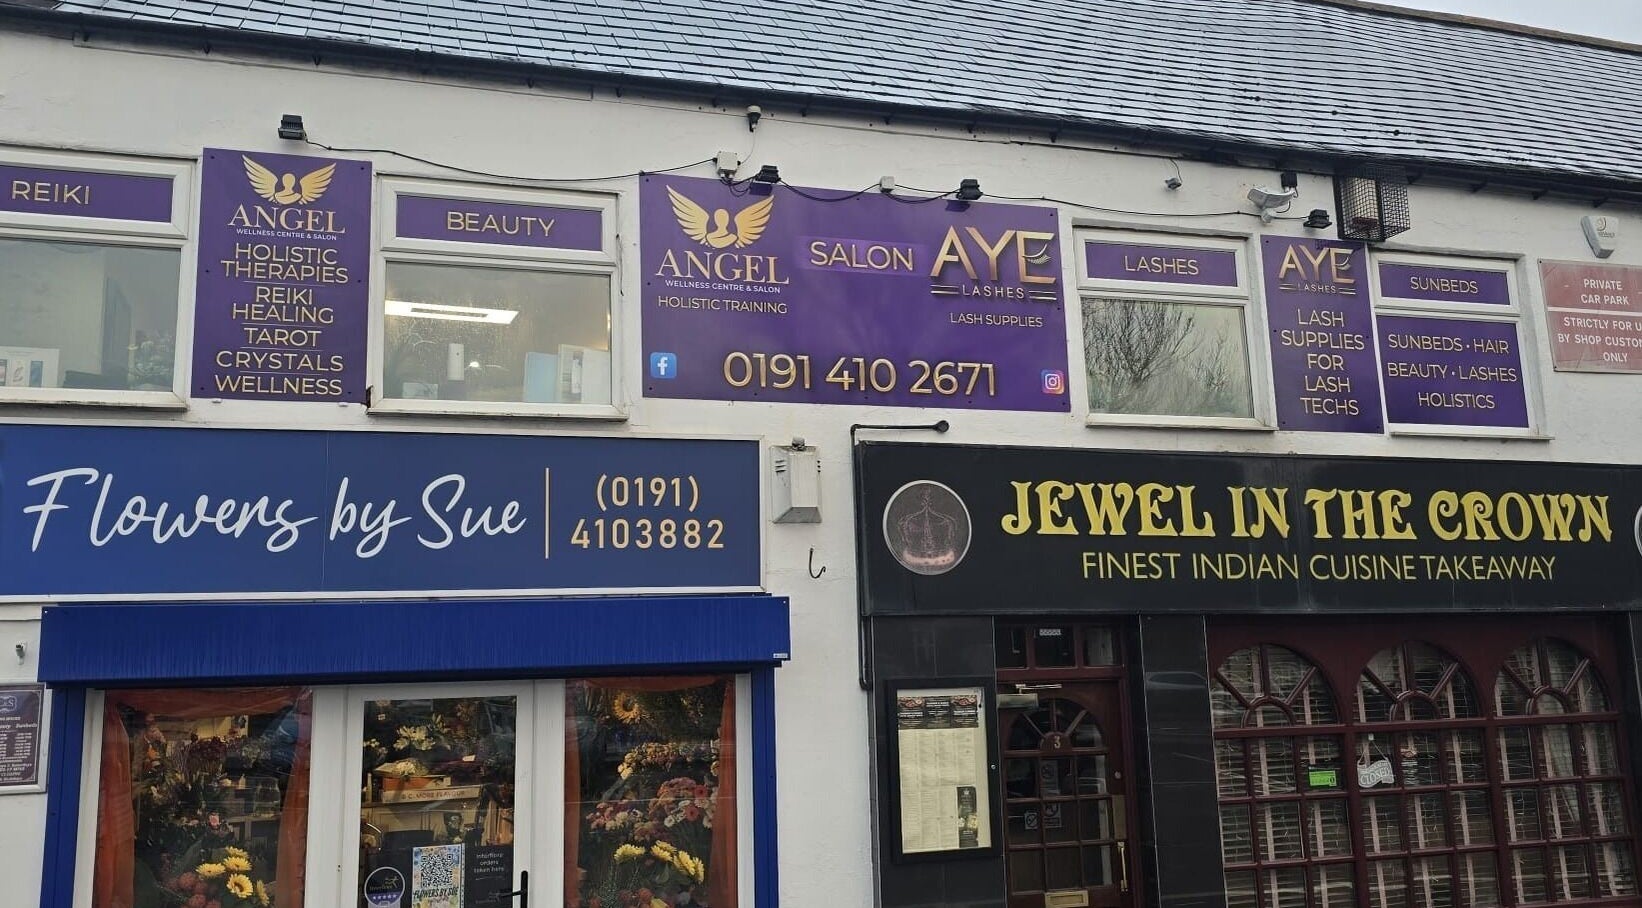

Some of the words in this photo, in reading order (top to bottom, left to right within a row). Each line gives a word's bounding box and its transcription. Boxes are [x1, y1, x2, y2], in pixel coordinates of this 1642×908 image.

[11, 180, 90, 205] REIKI
[227, 203, 346, 234] ANGEL
[446, 211, 556, 237] BEAUTY
[236, 228, 275, 237] WELLNESS
[276, 231, 305, 239] CENTRE
[235, 242, 338, 265] HOLISTIC
[810, 241, 914, 272] SALON
[930, 225, 1057, 284] AYE
[220, 260, 349, 284] THERAPIES
[655, 248, 790, 285] ANGEL
[1124, 255, 1200, 276] LASHES
[1278, 244, 1356, 284] AYE
[665, 279, 710, 289] WELLNESS
[712, 282, 745, 291] CENTRE
[753, 286, 781, 294] SALON
[962, 285, 1025, 299] LASHES
[1297, 283, 1336, 294] LASHES
[1410, 276, 1479, 294] SUNBEDS
[1583, 278, 1623, 291] PRIVATE
[255, 286, 313, 305] REIKI
[658, 295, 721, 310] HOLISTIC
[723, 299, 788, 314] TRAINING
[1580, 293, 1601, 304] CAR
[1603, 295, 1629, 305] PARK
[231, 303, 334, 324] HEALING
[950, 312, 983, 325] LASH
[985, 314, 1043, 328] SUPPLIES
[1297, 309, 1345, 328] LASH
[1563, 316, 1609, 330] STRICTLY
[1612, 320, 1632, 332] FOR
[244, 327, 322, 348] TAROT
[1280, 330, 1365, 351] SUPPLIES
[1388, 334, 1463, 352] SUNBEDS
[1473, 339, 1510, 354] HAIR
[1557, 333, 1570, 344] BY
[1574, 334, 1602, 345] SHOP
[216, 350, 344, 372] CRYSTALS
[1307, 354, 1344, 371] FOR
[1603, 351, 1628, 363] ONLY
[724, 350, 811, 390] 0191
[825, 356, 897, 392] 410
[908, 359, 996, 397] 2671
[1387, 363, 1448, 379] BEAUTY
[1459, 366, 1518, 383] LASHES
[215, 375, 343, 396] WELLNESS
[1304, 375, 1351, 393] LASH
[1300, 397, 1359, 417] TECHS
[1418, 392, 1496, 410] HOLISTICS
[596, 474, 700, 512] (0191)
[23, 467, 319, 553] Flowers
[329, 477, 411, 559] by
[417, 473, 527, 550] Sue
[1001, 480, 1216, 537] JEWEL
[1226, 486, 1290, 539] IN
[1304, 487, 1418, 540] THE
[1427, 490, 1613, 543] CROWN
[570, 518, 725, 550] 4103882
[1083, 551, 1181, 580] FINEST
[1192, 552, 1299, 580] INDIAN
[1309, 554, 1416, 581] CUISINE
[1419, 555, 1556, 581] TAKEAWAY
[1053, 736, 1061, 749] 3
